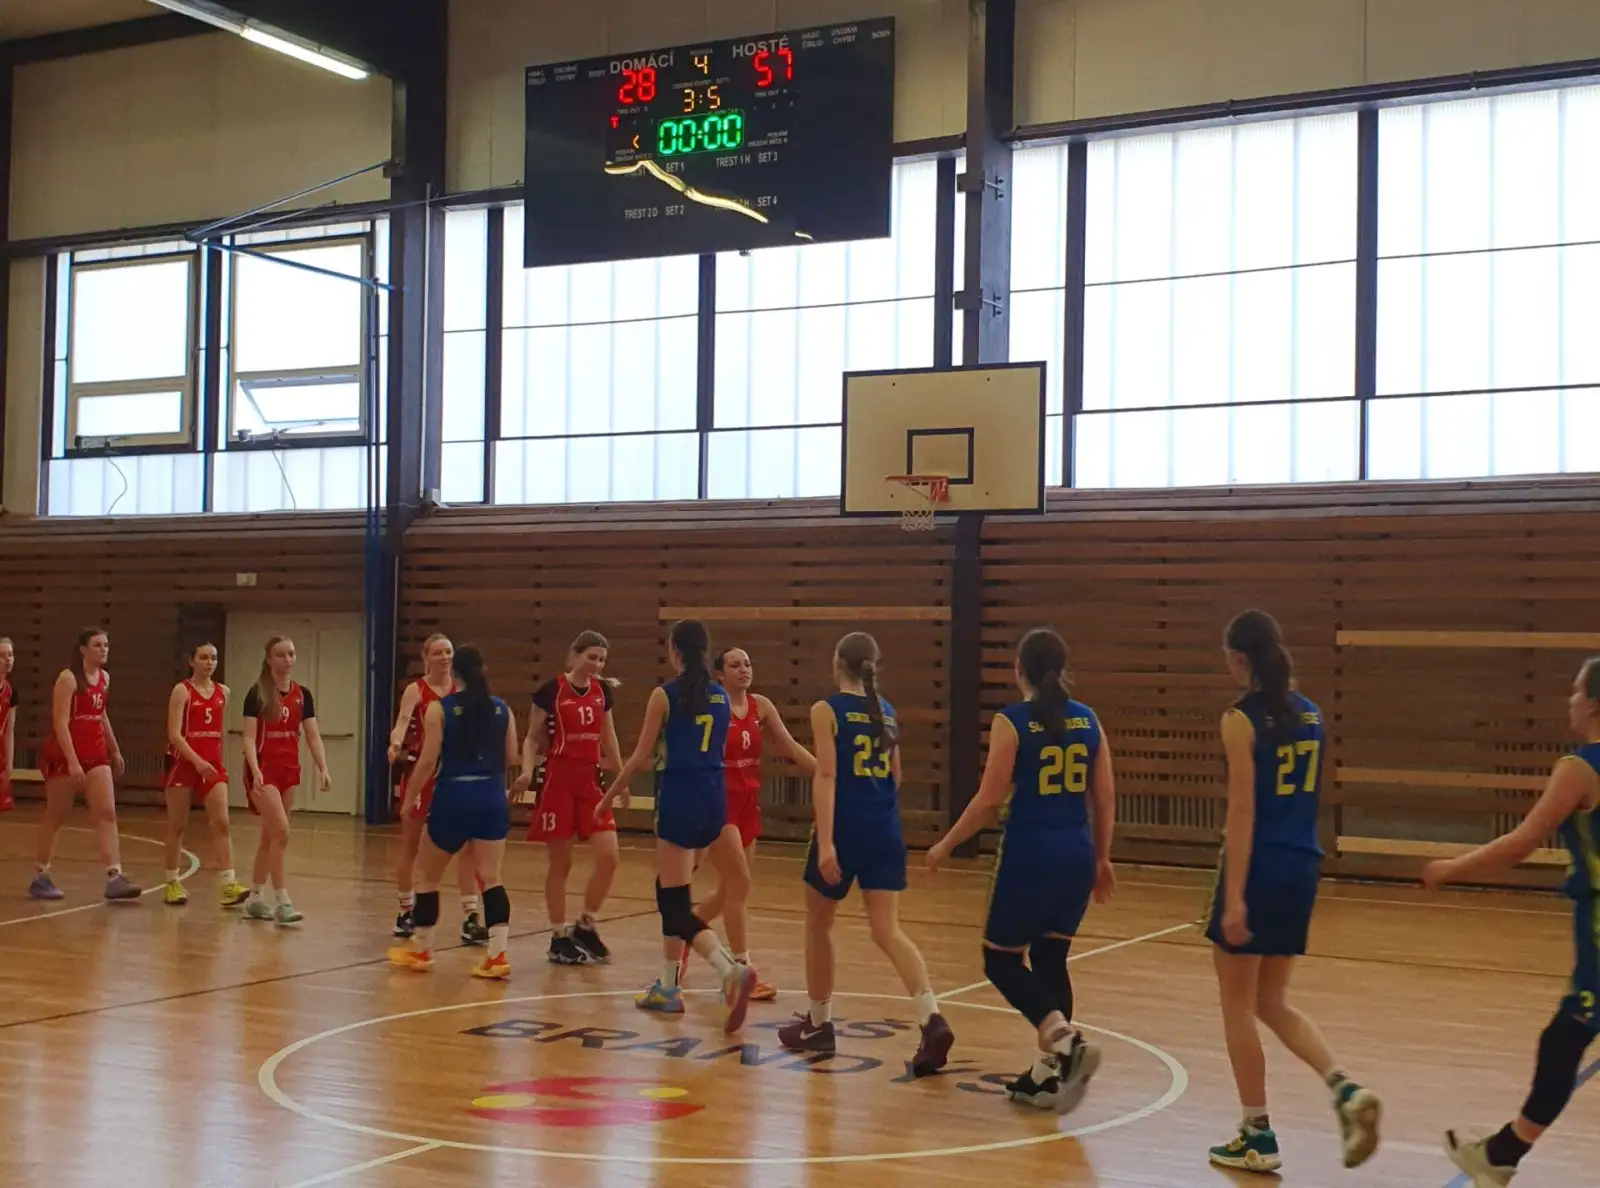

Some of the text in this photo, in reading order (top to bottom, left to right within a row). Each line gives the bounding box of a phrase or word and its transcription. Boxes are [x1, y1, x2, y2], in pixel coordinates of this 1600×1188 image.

[732, 35, 789, 58] HOSTÉ
[610, 50, 674, 74] DOMÁCÍ
[694, 55, 708, 75] 4
[752, 47, 793, 87] 57
[618, 67, 656, 104] 28
[683, 85, 721, 113] 3:5
[658, 114, 742, 155] 00:00
[665, 162, 679, 173] SET
[716, 155, 738, 168] TREST
[758, 151, 773, 163] SET
[665, 204, 684, 217] SET 2
[757, 196, 772, 208] SET
[772, 195, 778, 206] 4
[624, 208, 646, 220] TREST
[205, 707, 213, 724] 5
[577, 705, 595, 725] 13
[695, 714, 714, 752] 7
[741, 729, 751, 750] 8
[853, 734, 891, 778] 23
[1038, 743, 1088, 796] 26
[1275, 740, 1320, 796] 27
[541, 811, 556, 832] 13
